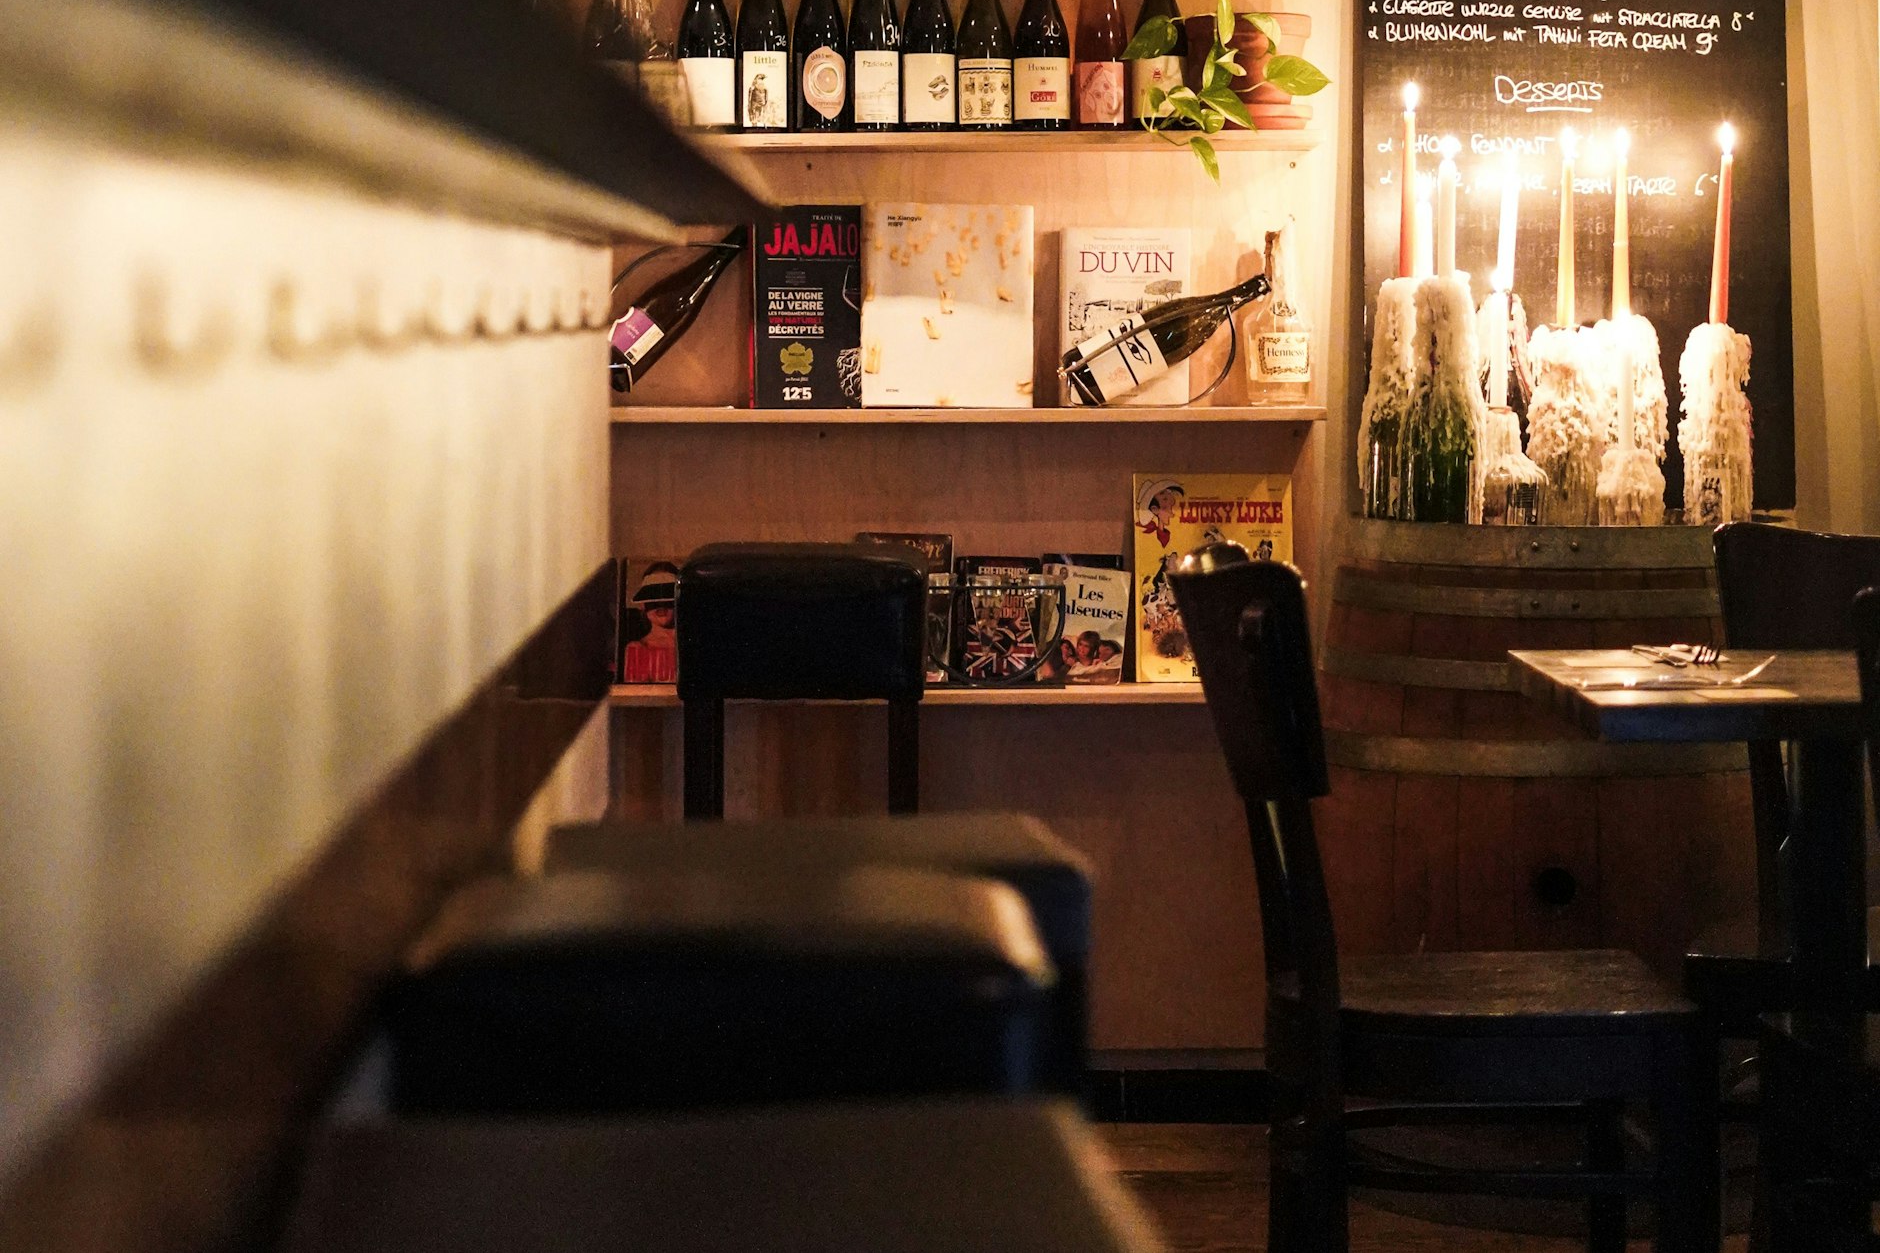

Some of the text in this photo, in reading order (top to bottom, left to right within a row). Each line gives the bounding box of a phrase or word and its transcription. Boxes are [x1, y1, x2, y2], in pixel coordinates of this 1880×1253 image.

[753, 55, 777, 65] little
[1079, 251, 1175, 274] DU VIN
[768, 291, 824, 301] DE LA VIGNE
[768, 300, 824, 311] AU VERRE
[768, 324, 825, 335] DÉCRYPTÉS
[1179, 501, 1283, 524] LUCKY LUKE
[1078, 583, 1104, 601] Les
